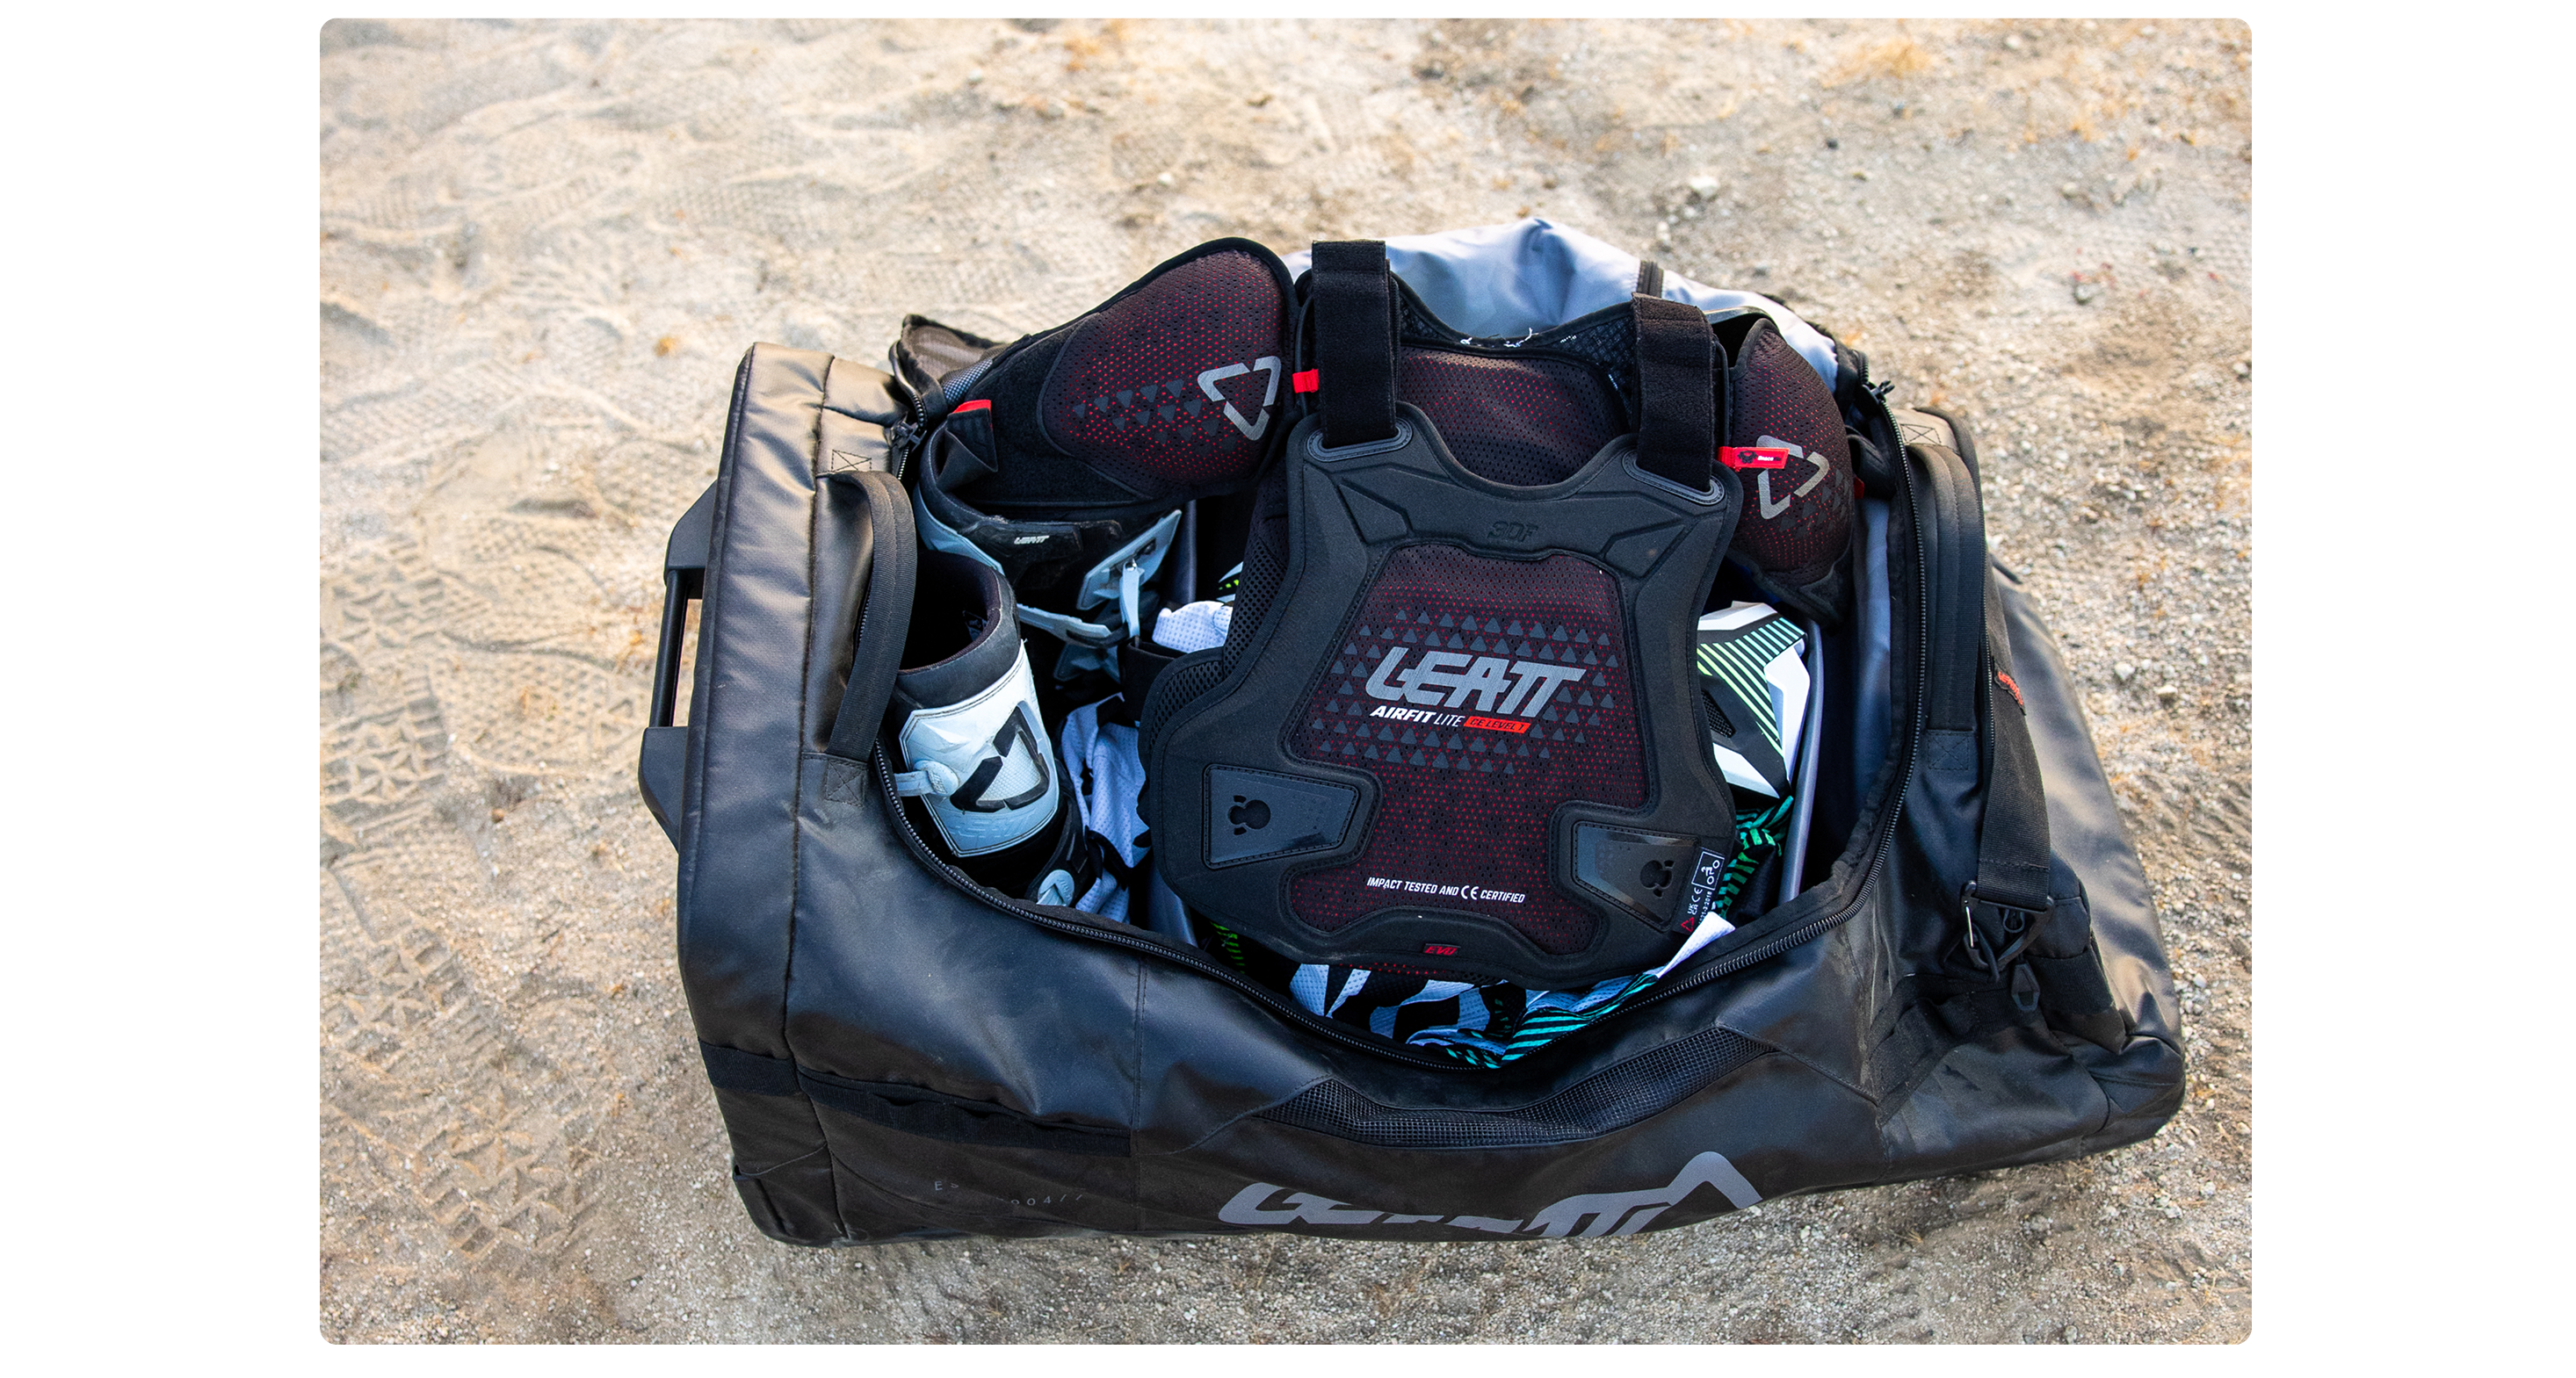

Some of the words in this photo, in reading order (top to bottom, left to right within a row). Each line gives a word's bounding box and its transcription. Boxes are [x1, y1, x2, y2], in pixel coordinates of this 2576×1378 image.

[1365, 646, 1587, 718] LEATT
[1370, 705, 1436, 723] AIRFIT
[1433, 712, 1465, 727] LITE
[1486, 720, 1516, 731] LEVEL
[1366, 877, 1403, 890] IMPACT
[1404, 881, 1438, 894] TESTED
[1439, 885, 1459, 896] AND
[1480, 890, 1526, 904] CERTIFIED
[1424, 945, 1458, 956] EVO
